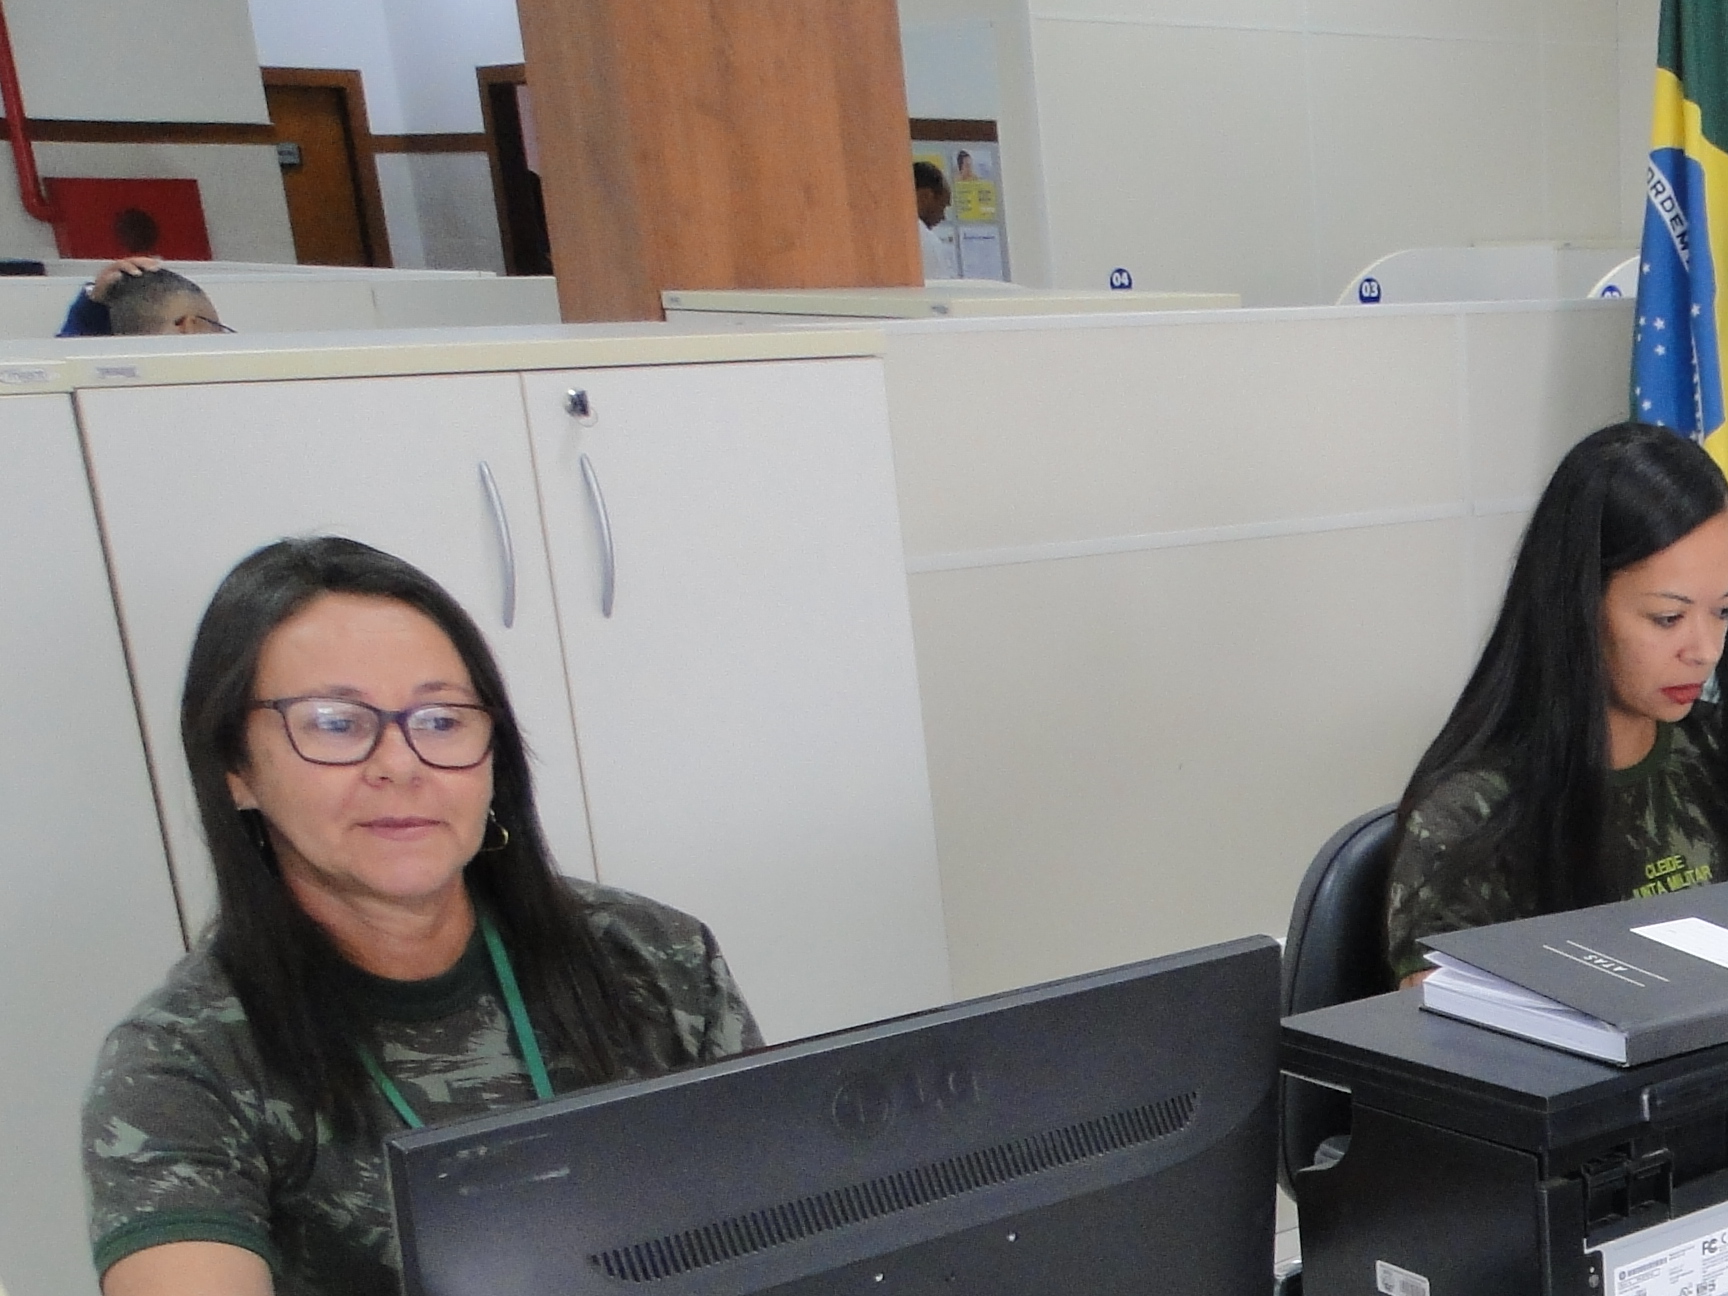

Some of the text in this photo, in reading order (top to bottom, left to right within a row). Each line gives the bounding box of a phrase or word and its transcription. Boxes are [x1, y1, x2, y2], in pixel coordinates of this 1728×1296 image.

[1111, 271, 1130, 287] 04
[1361, 281, 1379, 297] 03
[1582, 954, 1629, 972] ATAS
